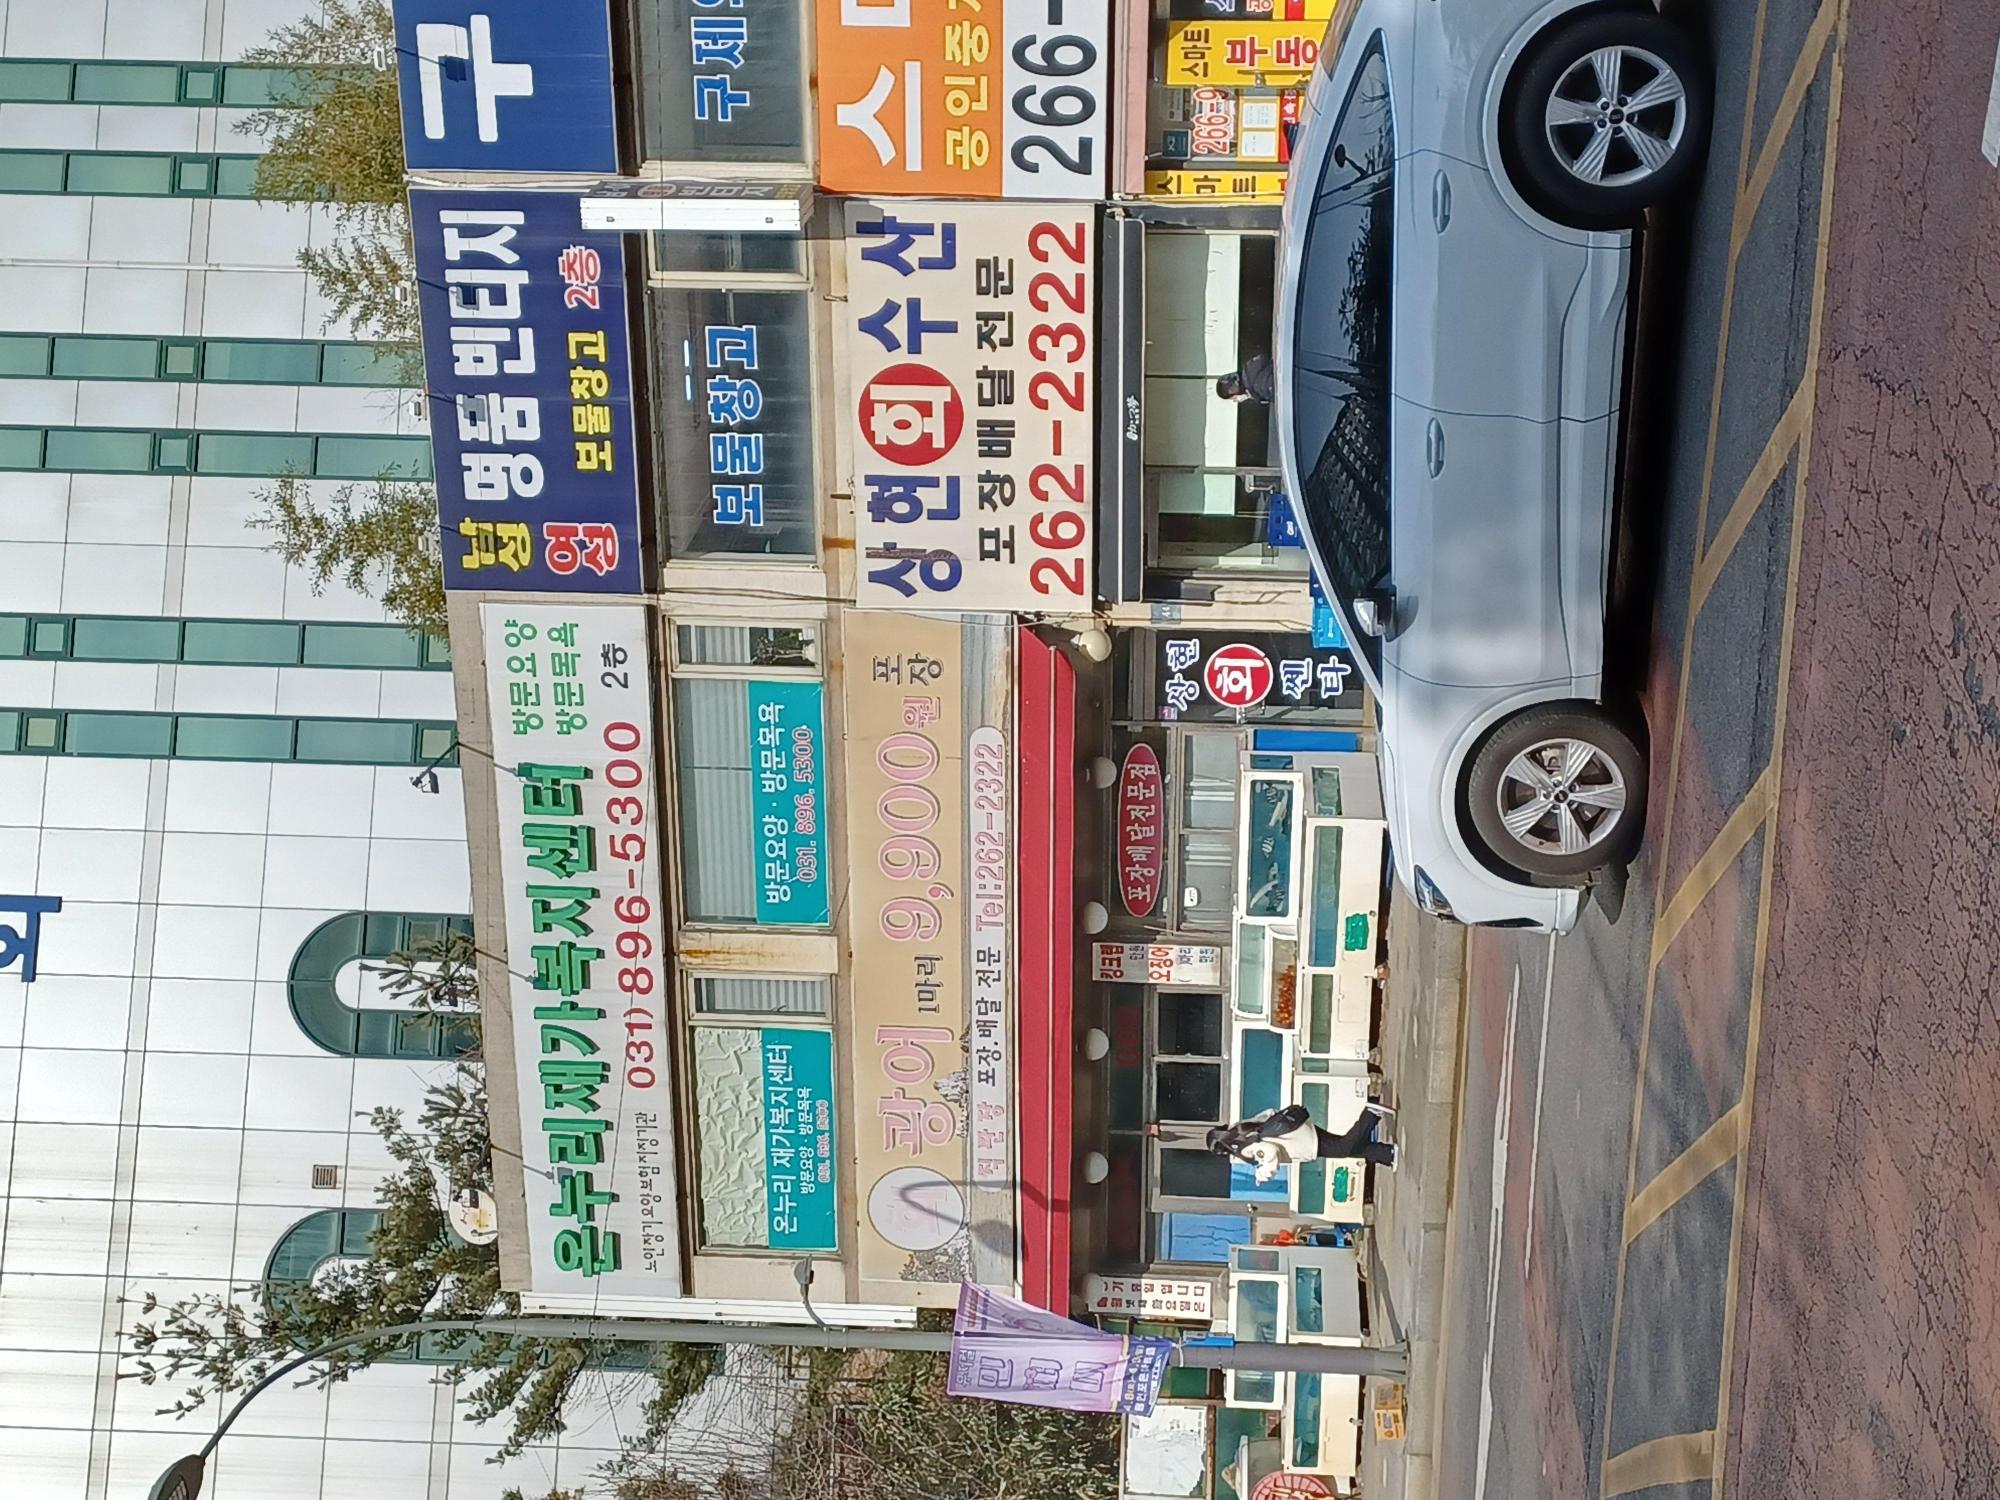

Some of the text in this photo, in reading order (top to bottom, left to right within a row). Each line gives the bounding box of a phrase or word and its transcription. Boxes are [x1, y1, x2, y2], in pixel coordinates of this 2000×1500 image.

[415, 14, 534, 143] 구
[690, 0, 750, 123] 구제
[944, 0, 991, 171] 공인중
[1180, 27, 1213, 78] 스마트
[1156, 175, 1256, 195] 스마트
[439, 209, 544, 500] 명품 빈티지
[558, 244, 613, 472] 보물창고 2층
[1027, 221, 1087, 596] 262-2322
[705, 325, 764, 527] 보물창고
[458, 517, 532, 572] 남성
[543, 521, 619, 576] 여성
[503, 618, 544, 736] 방문요양
[547, 621, 588, 736] 방문목욕
[600, 642, 629, 689] 2층
[872, 651, 944, 687] 포장
[1164, 638, 1200, 711] 상현
[757, 702, 791, 904] 방문요양 방문목욕
[792, 726, 814, 784] 5300
[1125, 762, 1156, 903] 포장배달전문점
[603, 721, 656, 1089] 031) 896-5300
[1149, 947, 1174, 982] 오징어
[515, 761, 621, 1278] 온누리재가복지센터
[975, 946, 1002, 989] 전문
[765, 1044, 798, 1235] 온누리 재가복지센터
[797, 1086, 815, 1195] 방문요양 방문목욕
[876, 1024, 956, 1157] 광어
